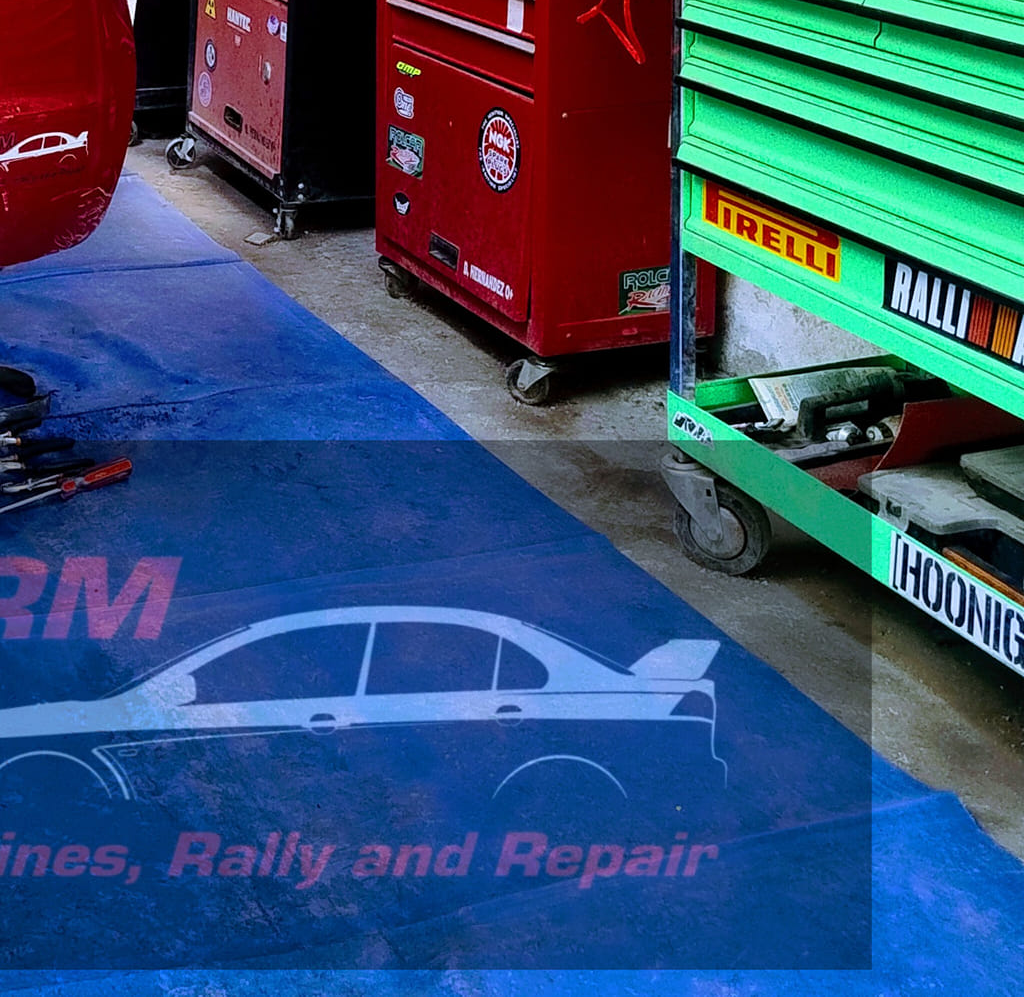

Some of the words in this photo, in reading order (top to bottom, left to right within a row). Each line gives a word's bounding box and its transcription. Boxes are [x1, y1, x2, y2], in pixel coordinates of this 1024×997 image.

[489, 130, 511, 154] NGK
[705, 179, 840, 279] PIRELLI
[890, 261, 972, 340] RALLI
